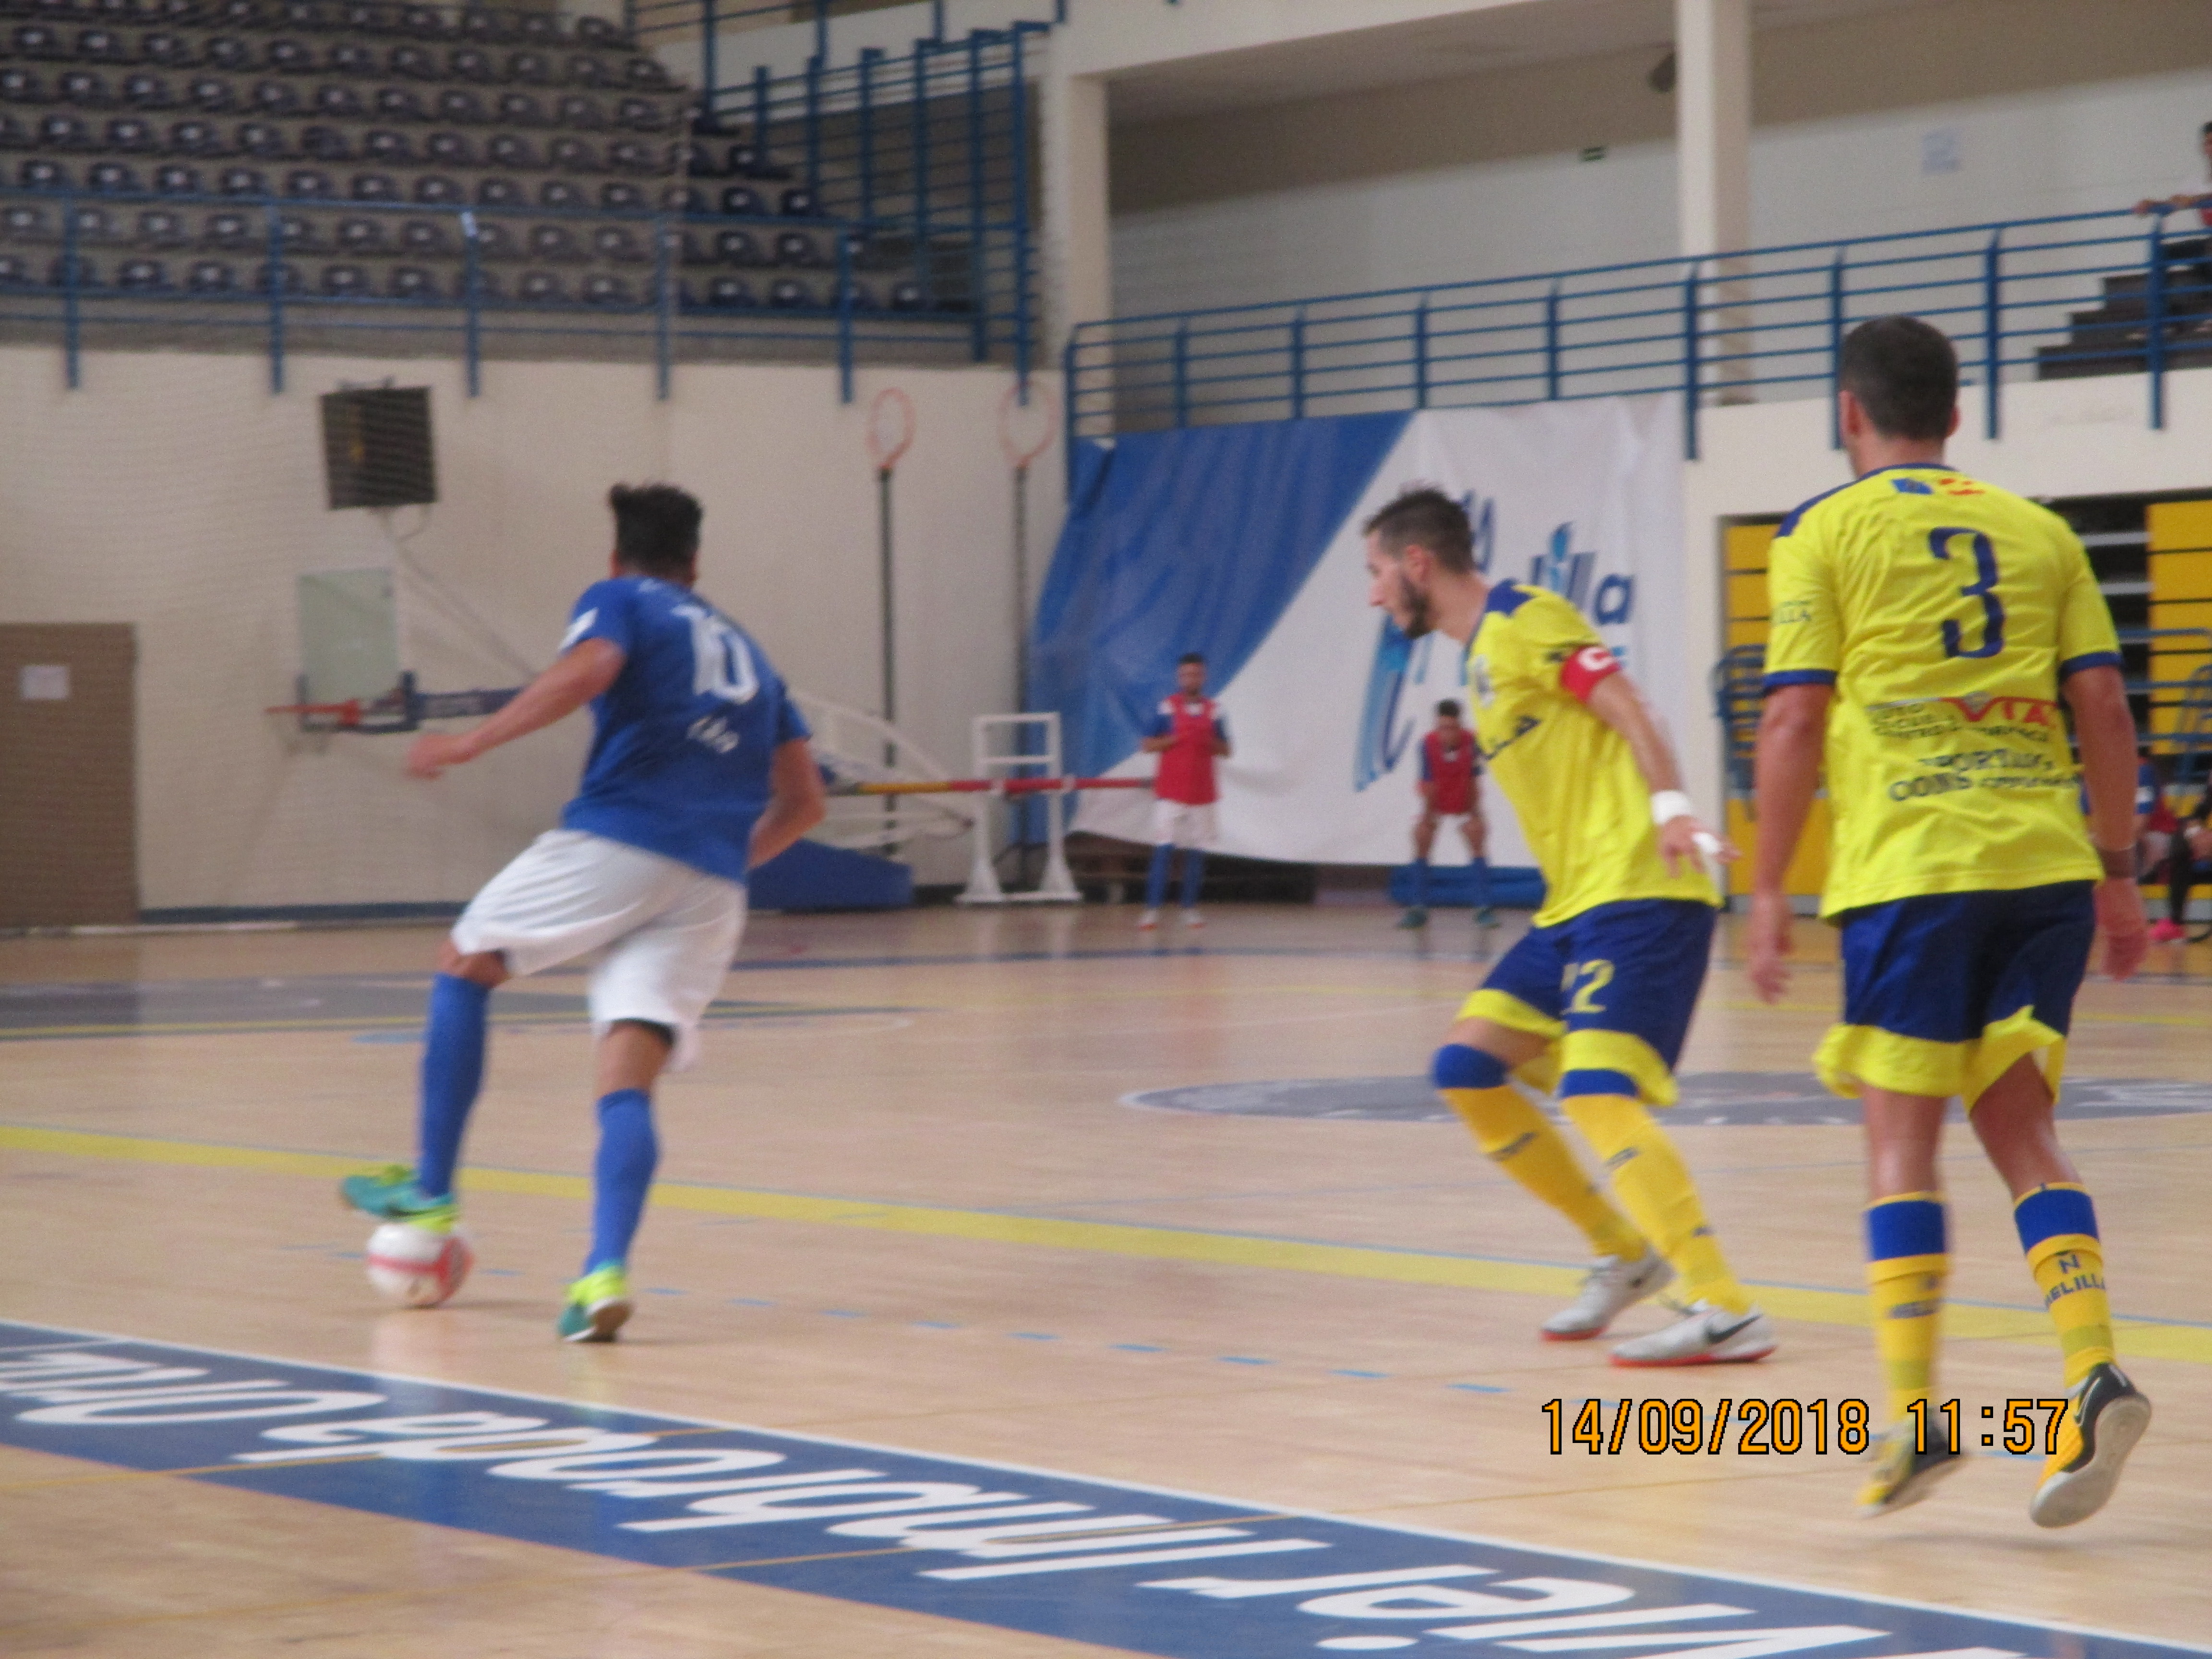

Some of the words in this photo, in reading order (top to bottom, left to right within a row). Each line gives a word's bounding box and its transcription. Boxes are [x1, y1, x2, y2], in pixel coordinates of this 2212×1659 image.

[670, 604, 760, 706] 10
[1928, 526, 2007, 659] 3
[229, 1410, 1333, 1580] Imbroda
